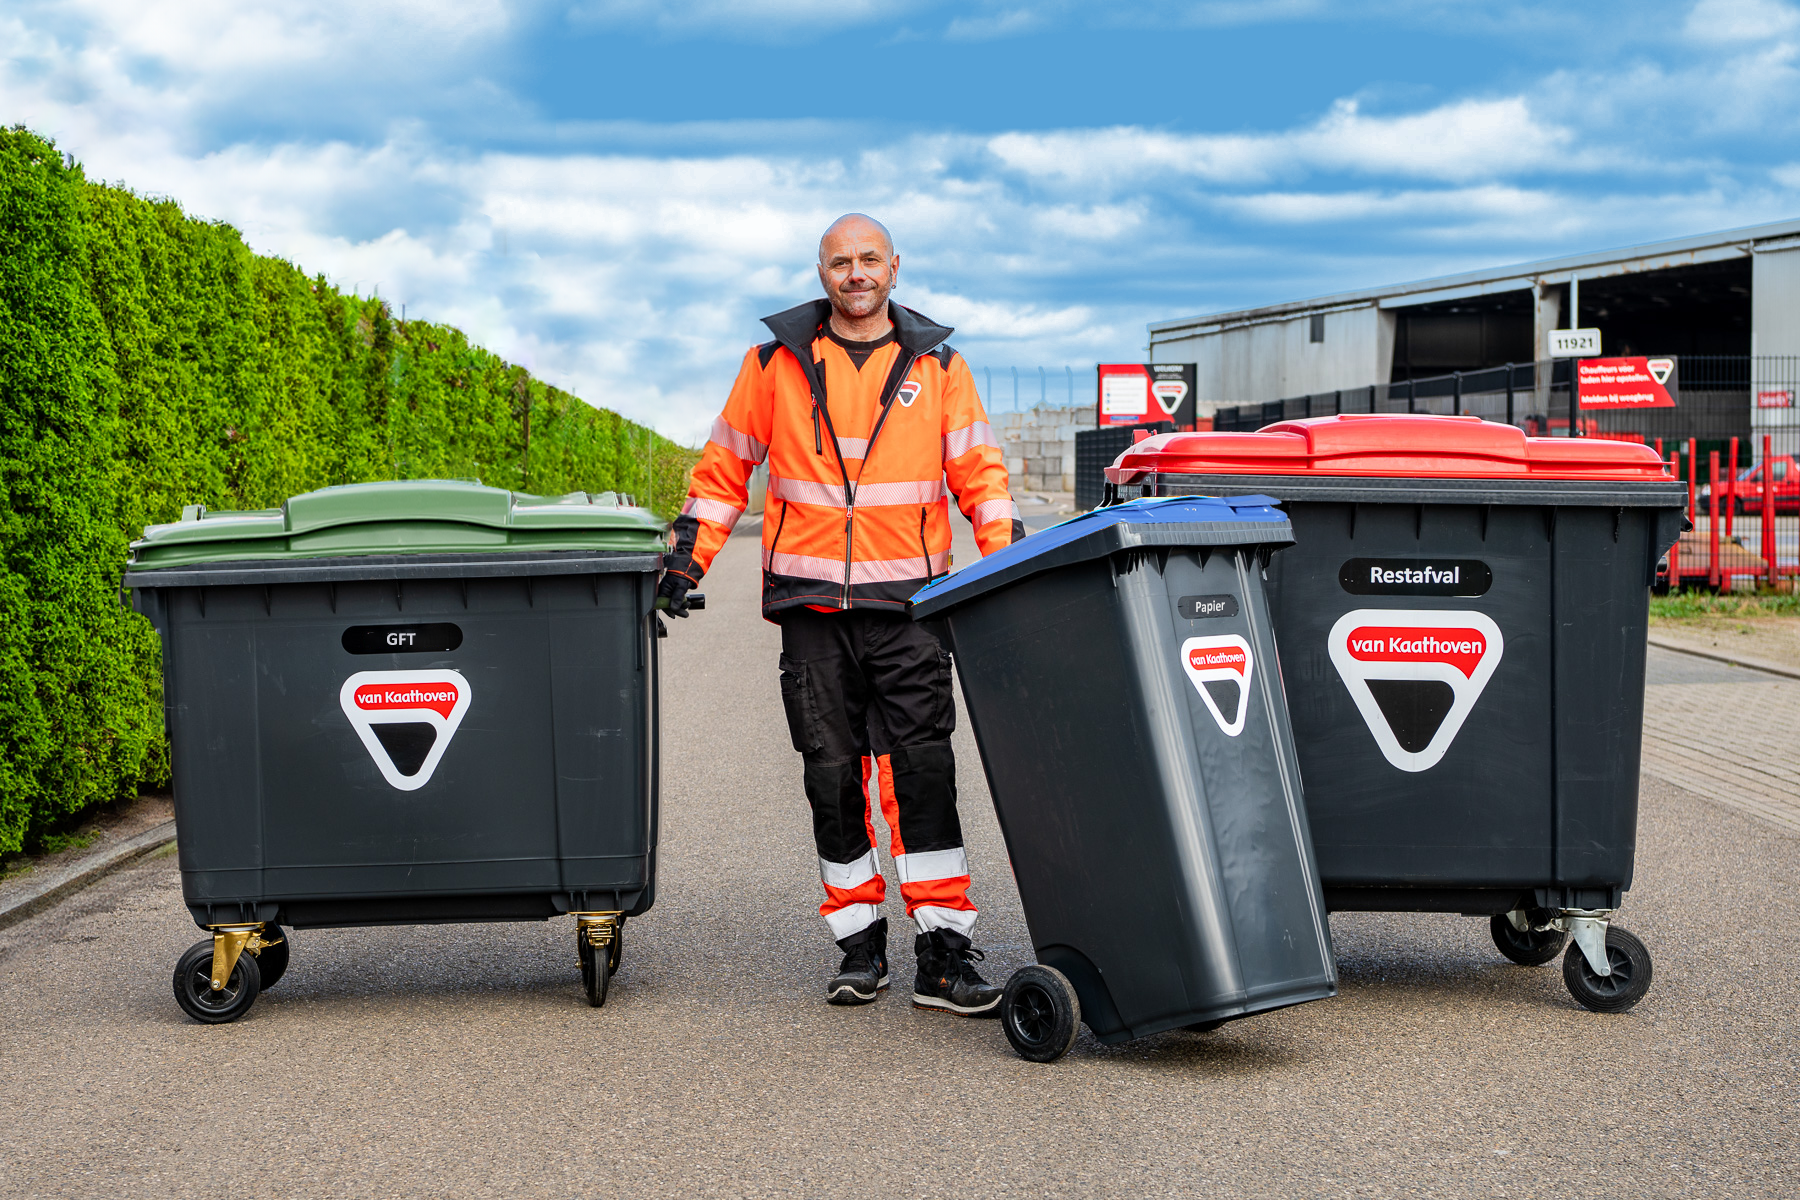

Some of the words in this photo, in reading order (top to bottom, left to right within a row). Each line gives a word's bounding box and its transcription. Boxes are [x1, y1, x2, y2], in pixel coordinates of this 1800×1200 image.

[1557, 337, 1593, 349] 11921
[1580, 365, 1618, 375] Chauffeurs
[1618, 365, 1635, 373] voor
[1580, 375, 1601, 384] laden
[1601, 375, 1616, 383] hier
[1581, 394, 1608, 403] Melden
[1608, 393, 1619, 403] bij
[1370, 566, 1460, 584] Restafval
[1195, 600, 1225, 614] Papier
[386, 632, 417, 646] GFT
[1352, 639, 1385, 653] van
[1389, 636, 1482, 654] Kaathoven
[1191, 656, 1205, 665] van
[1206, 653, 1245, 664] Kaathoven
[357, 693, 382, 704] van
[385, 690, 455, 703] Kaathoven
